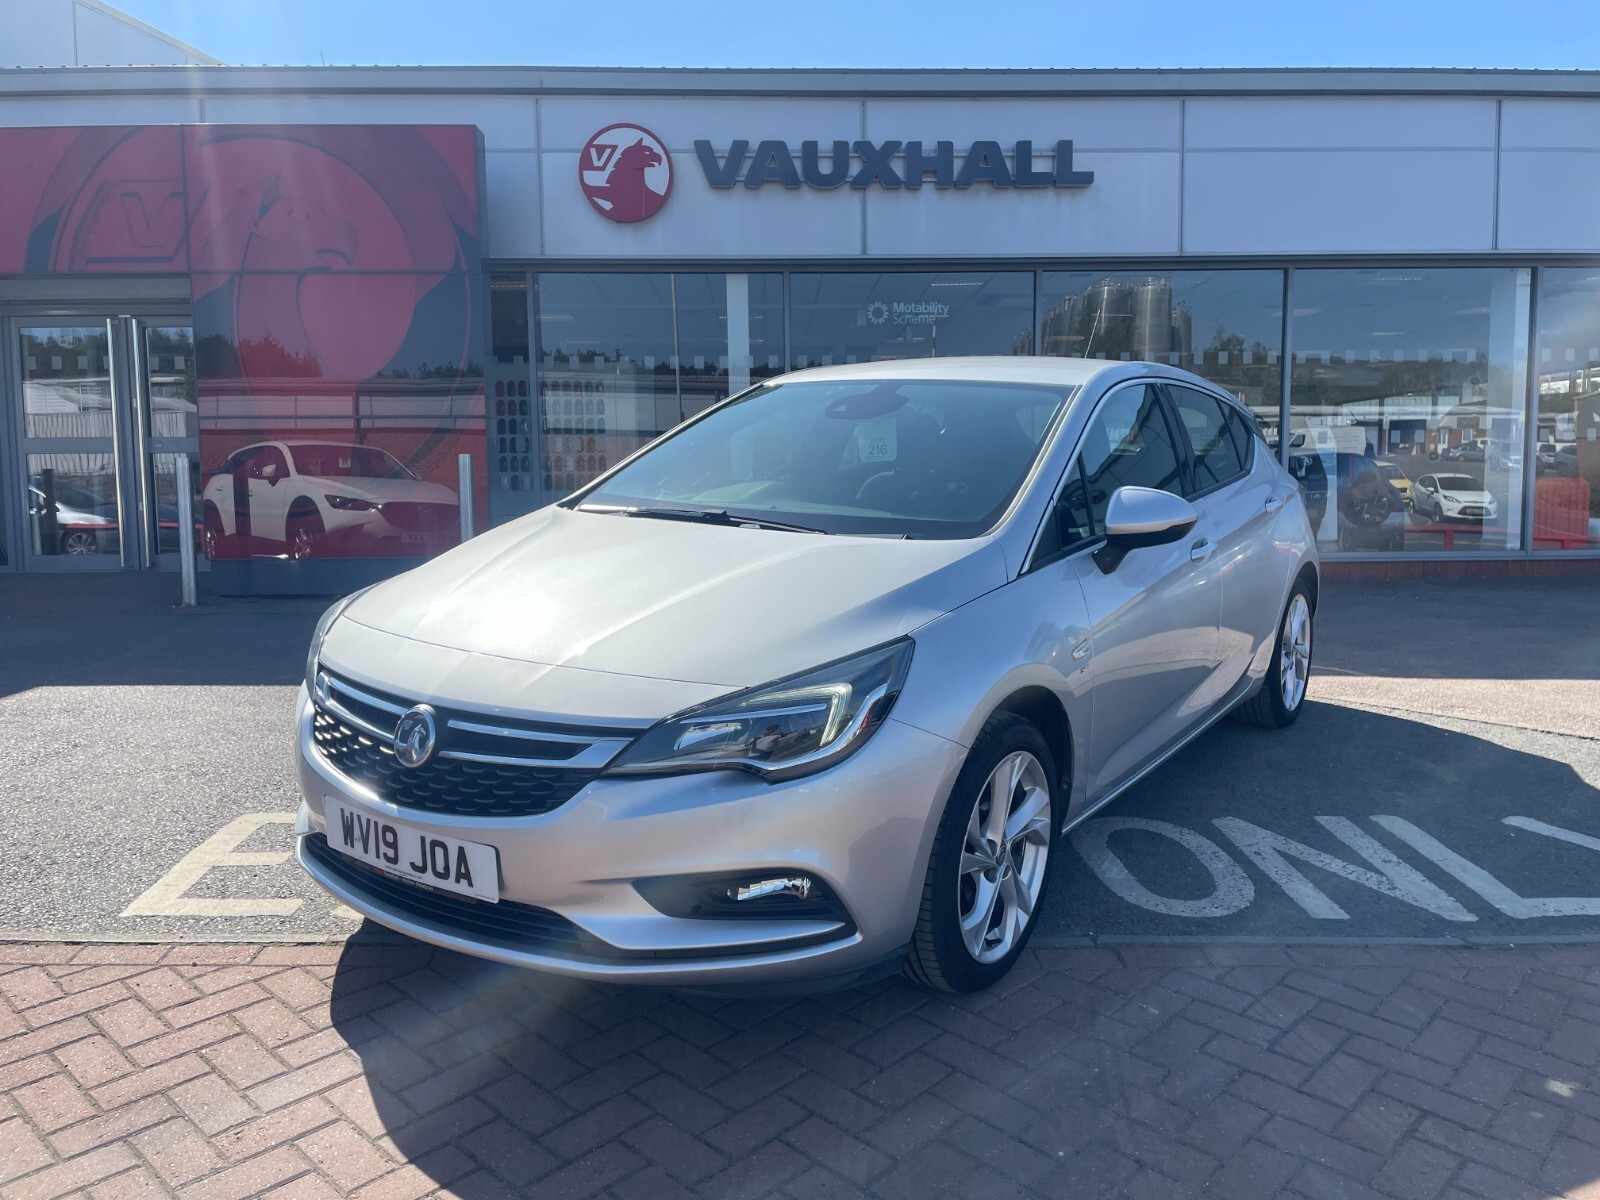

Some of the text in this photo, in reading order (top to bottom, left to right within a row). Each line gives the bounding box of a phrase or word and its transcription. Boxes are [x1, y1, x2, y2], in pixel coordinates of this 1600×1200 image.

[693, 139, 1095, 190] VAUXHALL
[893, 301, 950, 317] Motability
[893, 312, 936, 325] Scheme
[867, 443, 888, 457] 216
[339, 806, 400, 866] WV19
[409, 834, 475, 889] JOA
[1071, 814, 1600, 922] ONL
